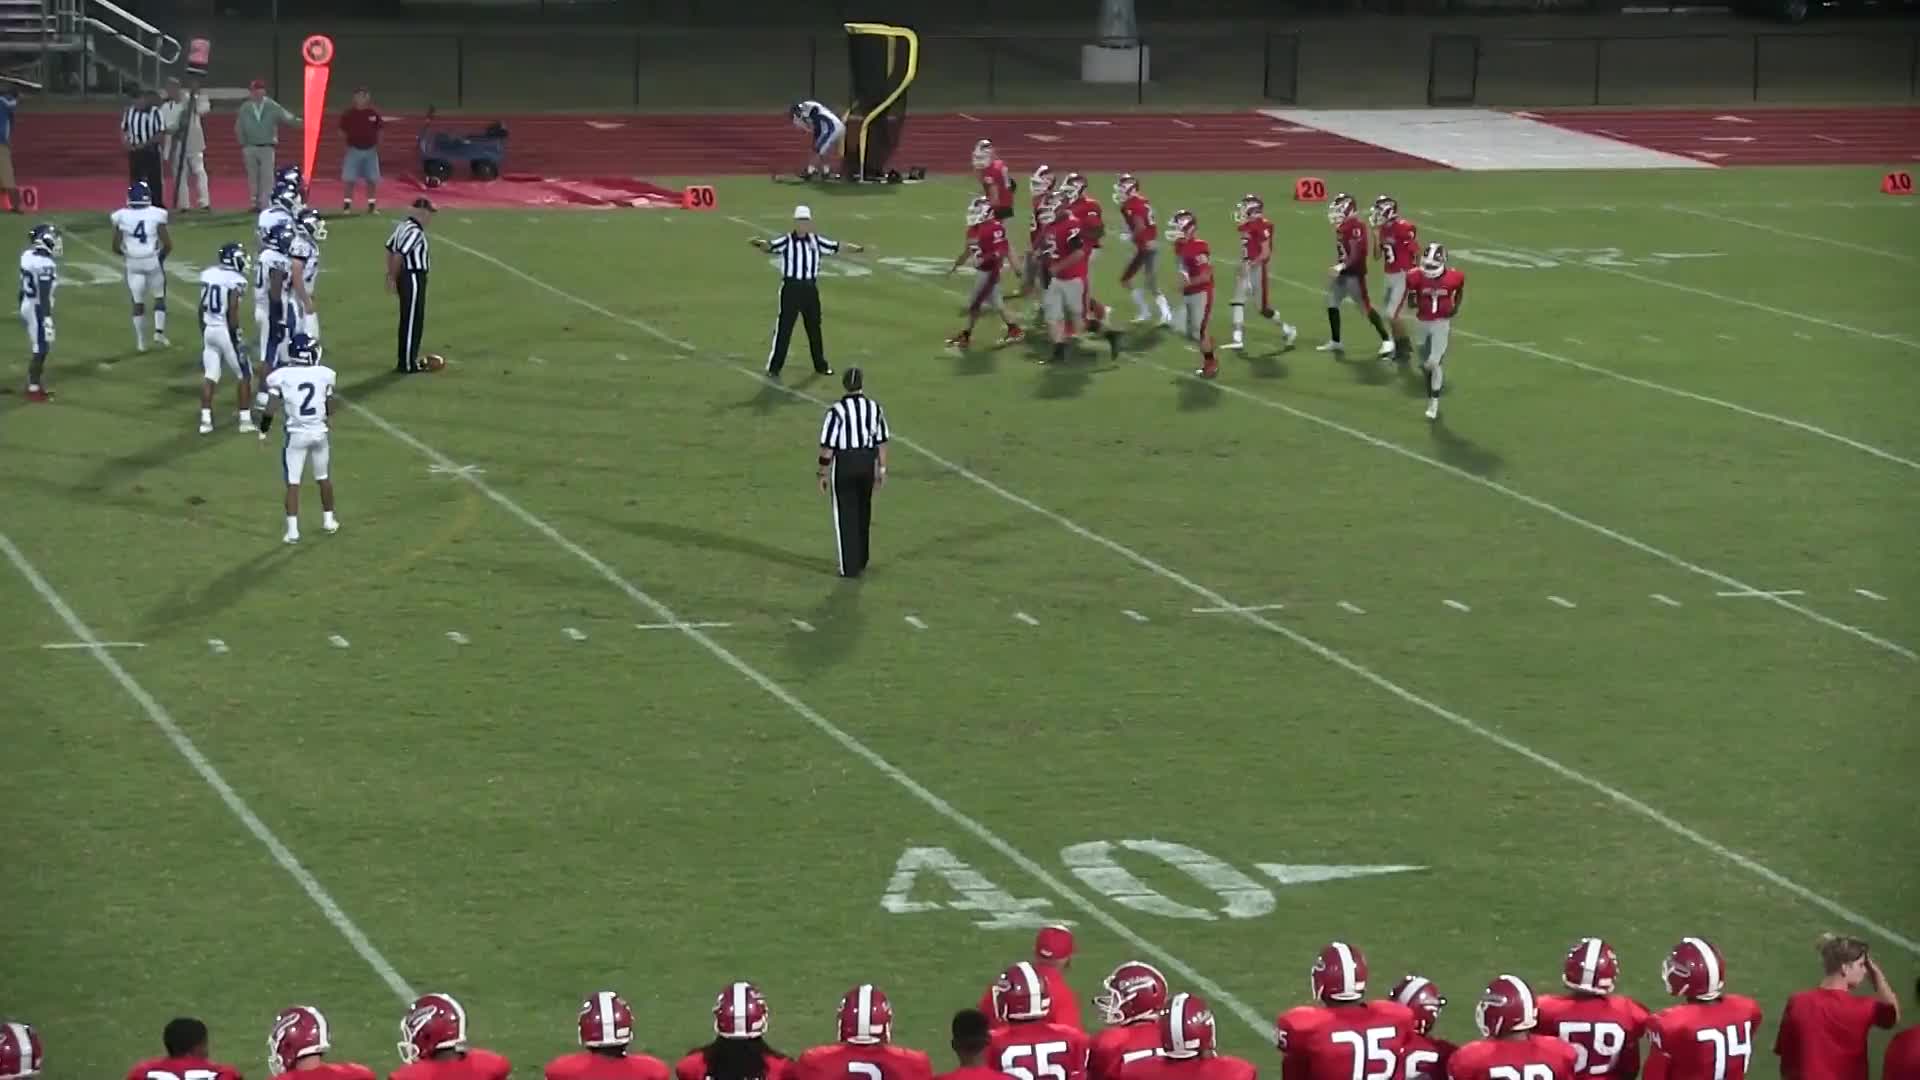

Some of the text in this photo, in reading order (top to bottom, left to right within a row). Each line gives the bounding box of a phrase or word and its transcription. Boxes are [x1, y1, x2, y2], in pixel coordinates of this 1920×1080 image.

[690, 187, 714, 207] 30
[1301, 180, 1325, 198] 20
[1889, 173, 1911, 190] 10
[133, 220, 147, 244] 4
[200, 282, 222, 314] 20
[297, 382, 316, 416] 2
[880, 839, 1278, 929] 40
[1331, 1026, 1397, 1080] 75
[1559, 1022, 1626, 1076] 59
[1697, 1020, 1752, 1080] 74
